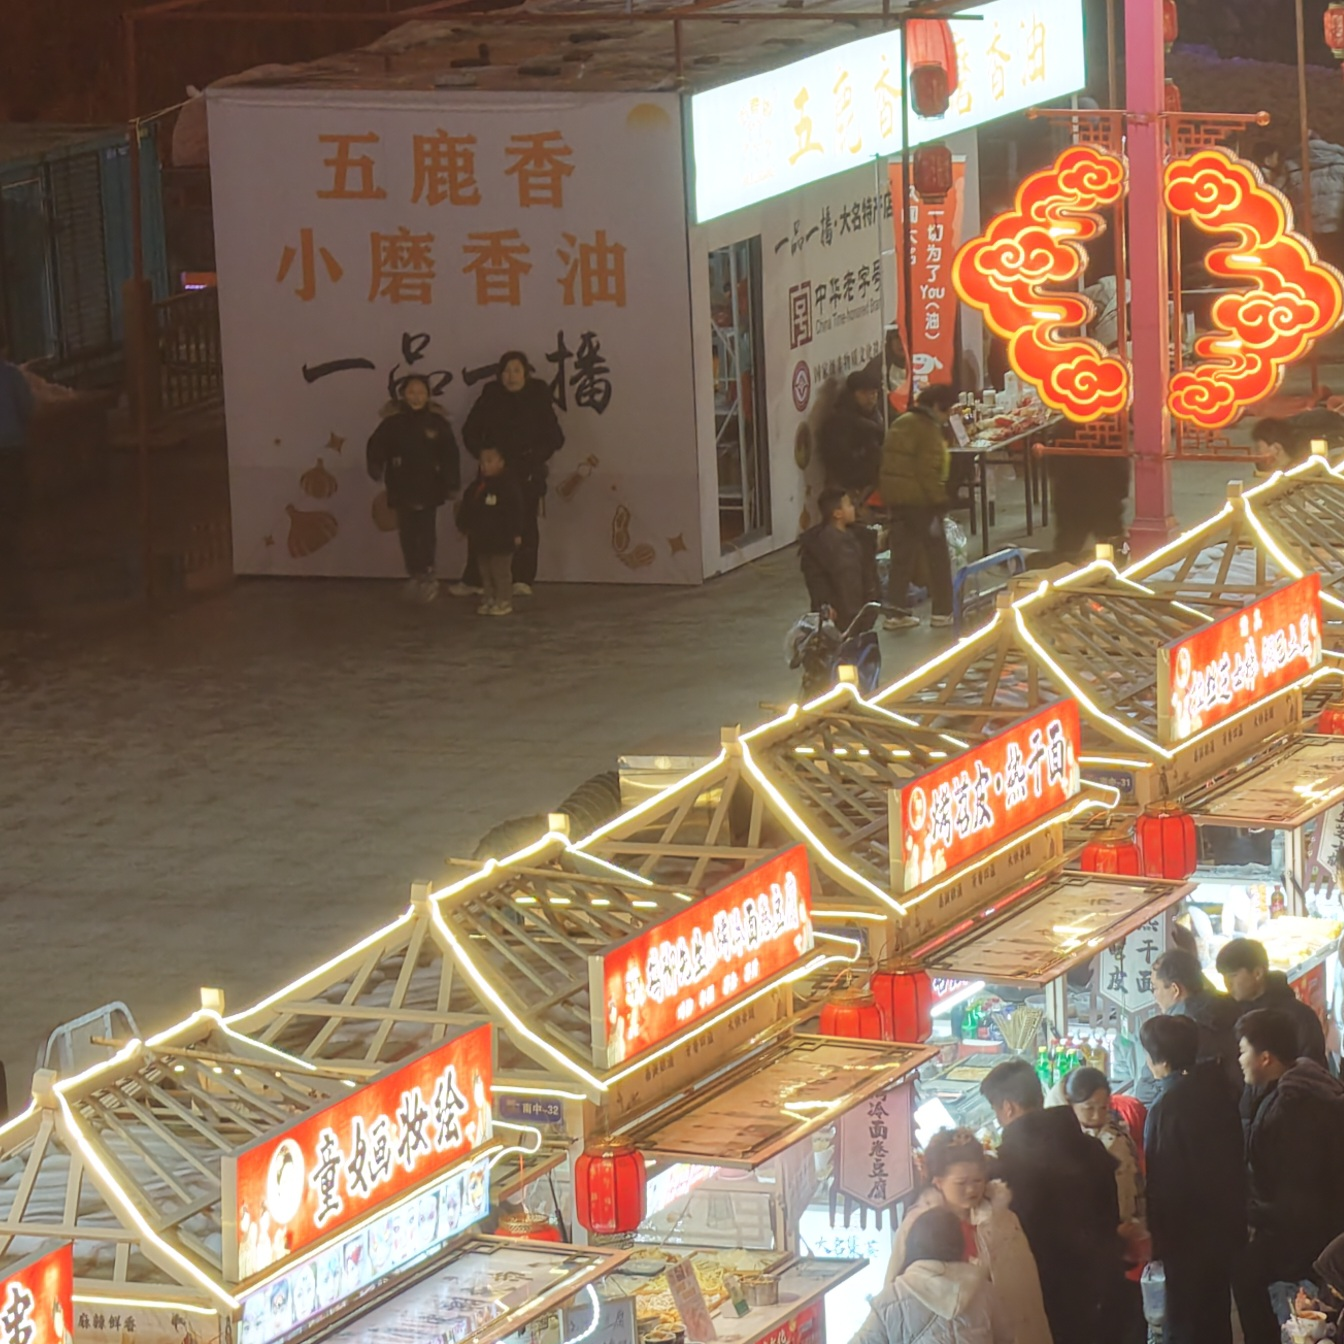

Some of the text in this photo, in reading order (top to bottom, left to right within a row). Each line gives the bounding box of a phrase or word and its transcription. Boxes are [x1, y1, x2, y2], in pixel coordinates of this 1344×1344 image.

[316, 127, 575, 209] 五鹿香
[276, 225, 628, 309] 小磨香油
